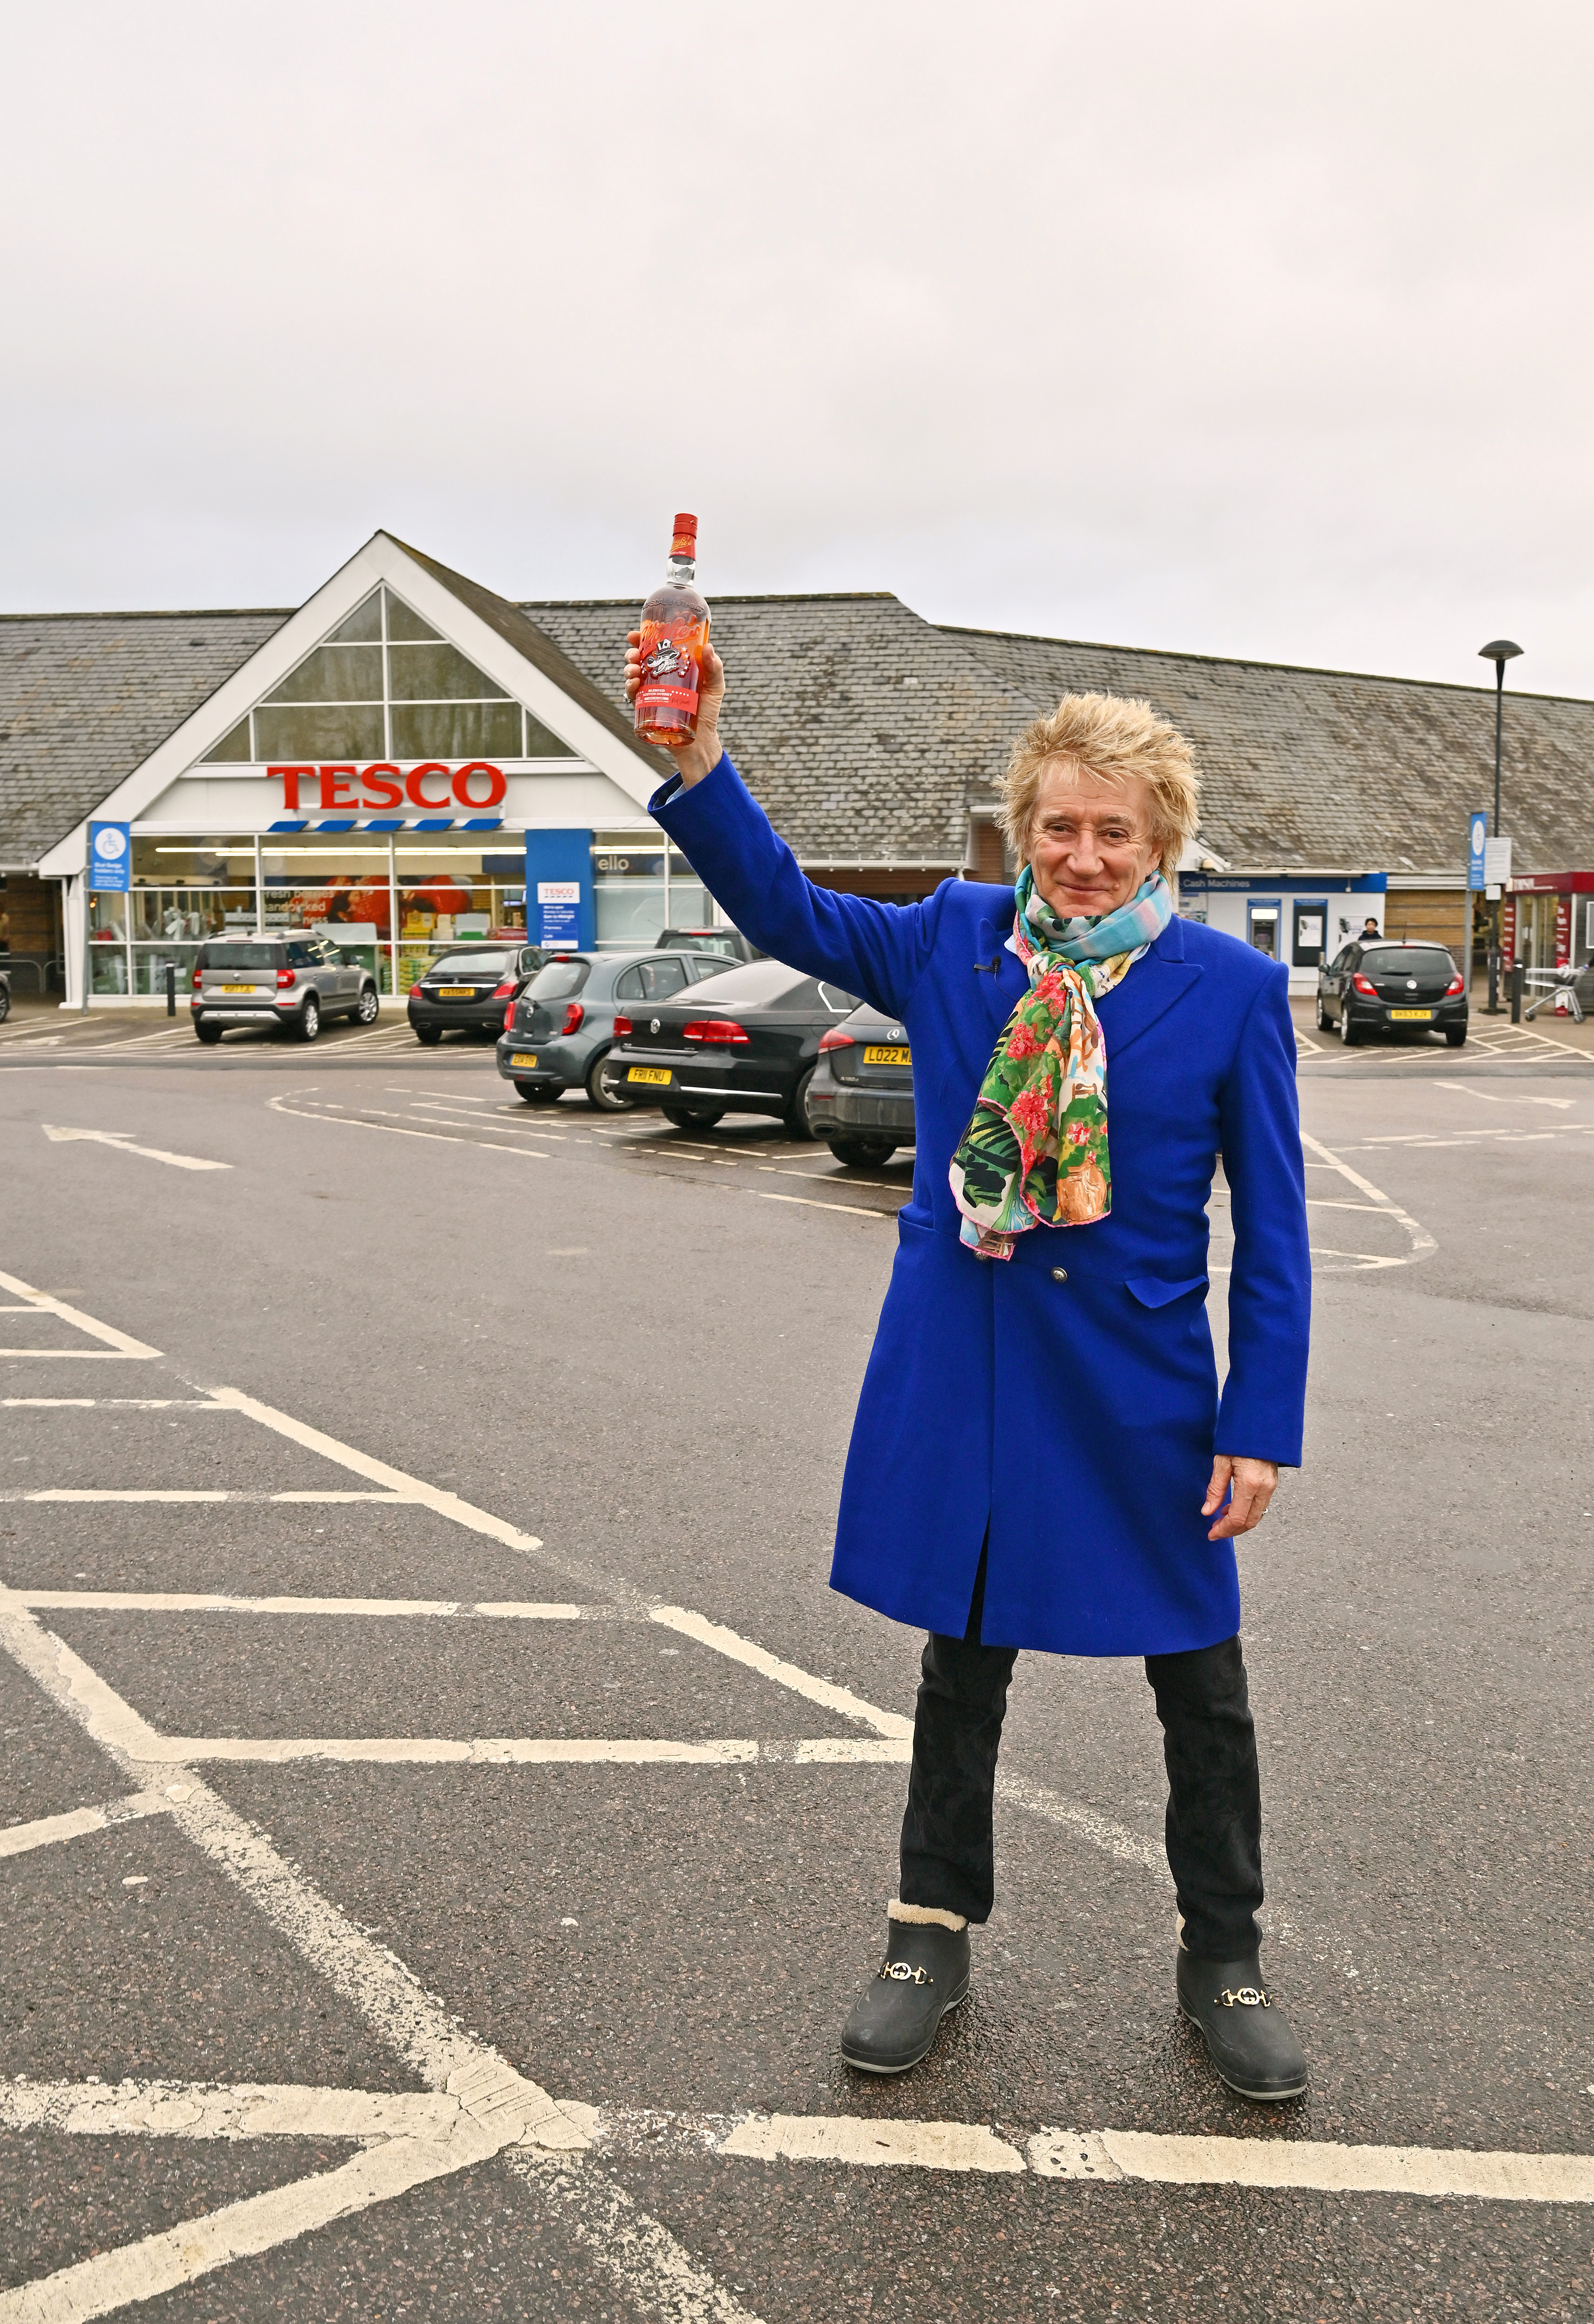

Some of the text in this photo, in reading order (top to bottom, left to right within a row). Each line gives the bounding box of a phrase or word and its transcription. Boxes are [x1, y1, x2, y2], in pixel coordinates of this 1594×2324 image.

[267, 762, 507, 809] TESCO
[1184, 879, 1250, 888] Cash Machines
[265, 901, 326, 913] andpicked
